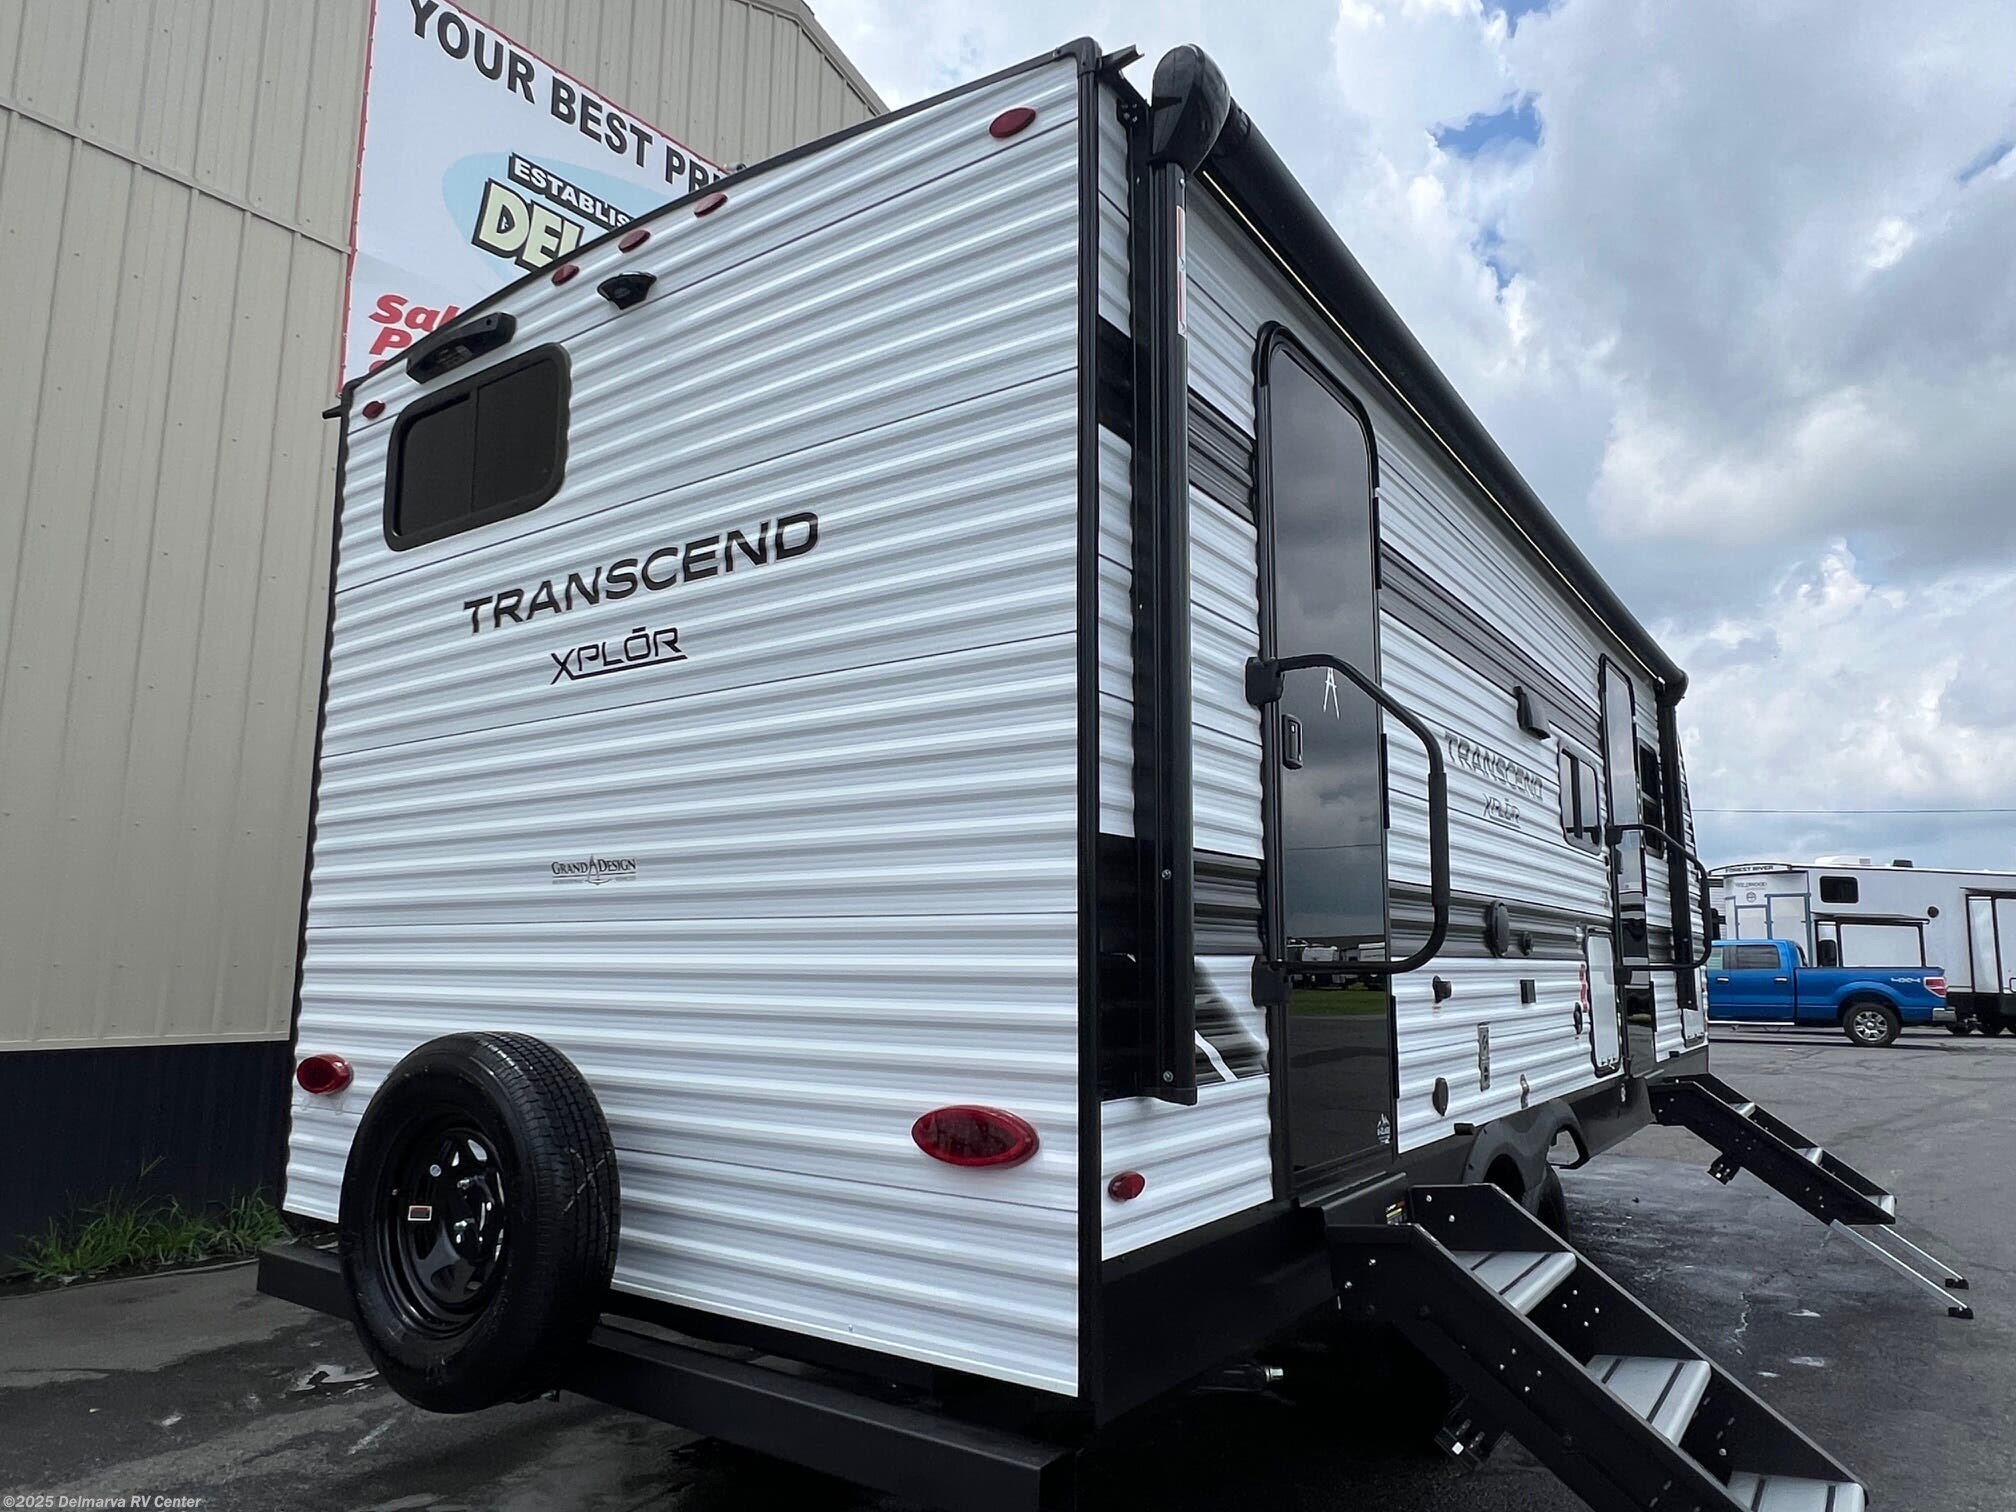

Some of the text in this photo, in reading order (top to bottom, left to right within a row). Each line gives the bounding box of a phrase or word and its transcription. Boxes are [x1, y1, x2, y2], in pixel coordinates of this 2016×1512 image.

[411, 0, 727, 193] YOUR BEST PR
[464, 512, 820, 634] TRANSCEND
[1444, 732, 1543, 800] TRANSCEND
[551, 858, 636, 875] GRAND DESIGN
